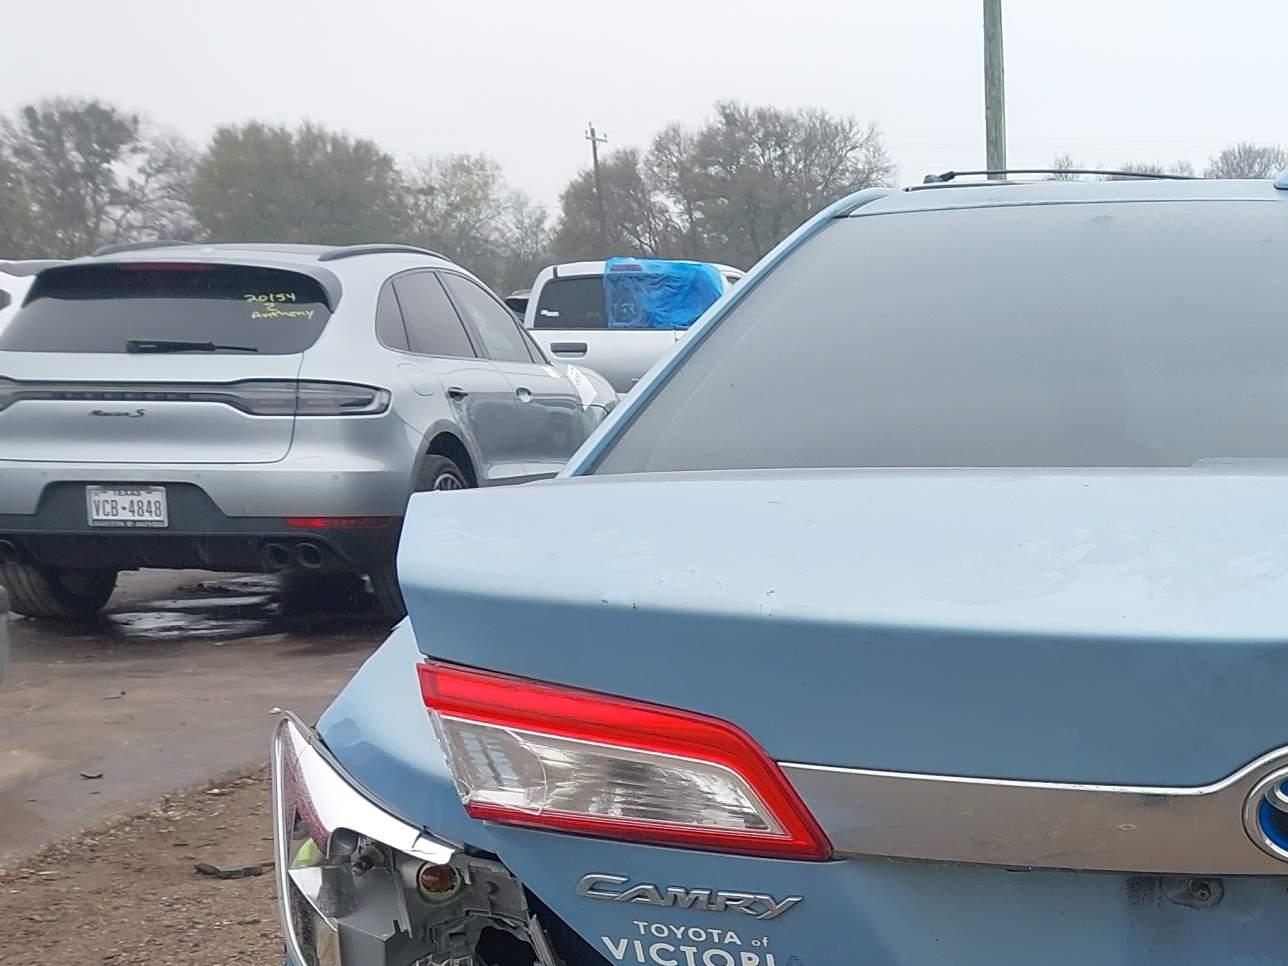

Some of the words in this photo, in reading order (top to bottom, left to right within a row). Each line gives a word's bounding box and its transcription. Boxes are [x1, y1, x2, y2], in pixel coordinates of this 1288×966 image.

[576, 873, 802, 920] CAMRY
[633, 920, 743, 946] TOYOTA
[751, 936, 769, 948] of
